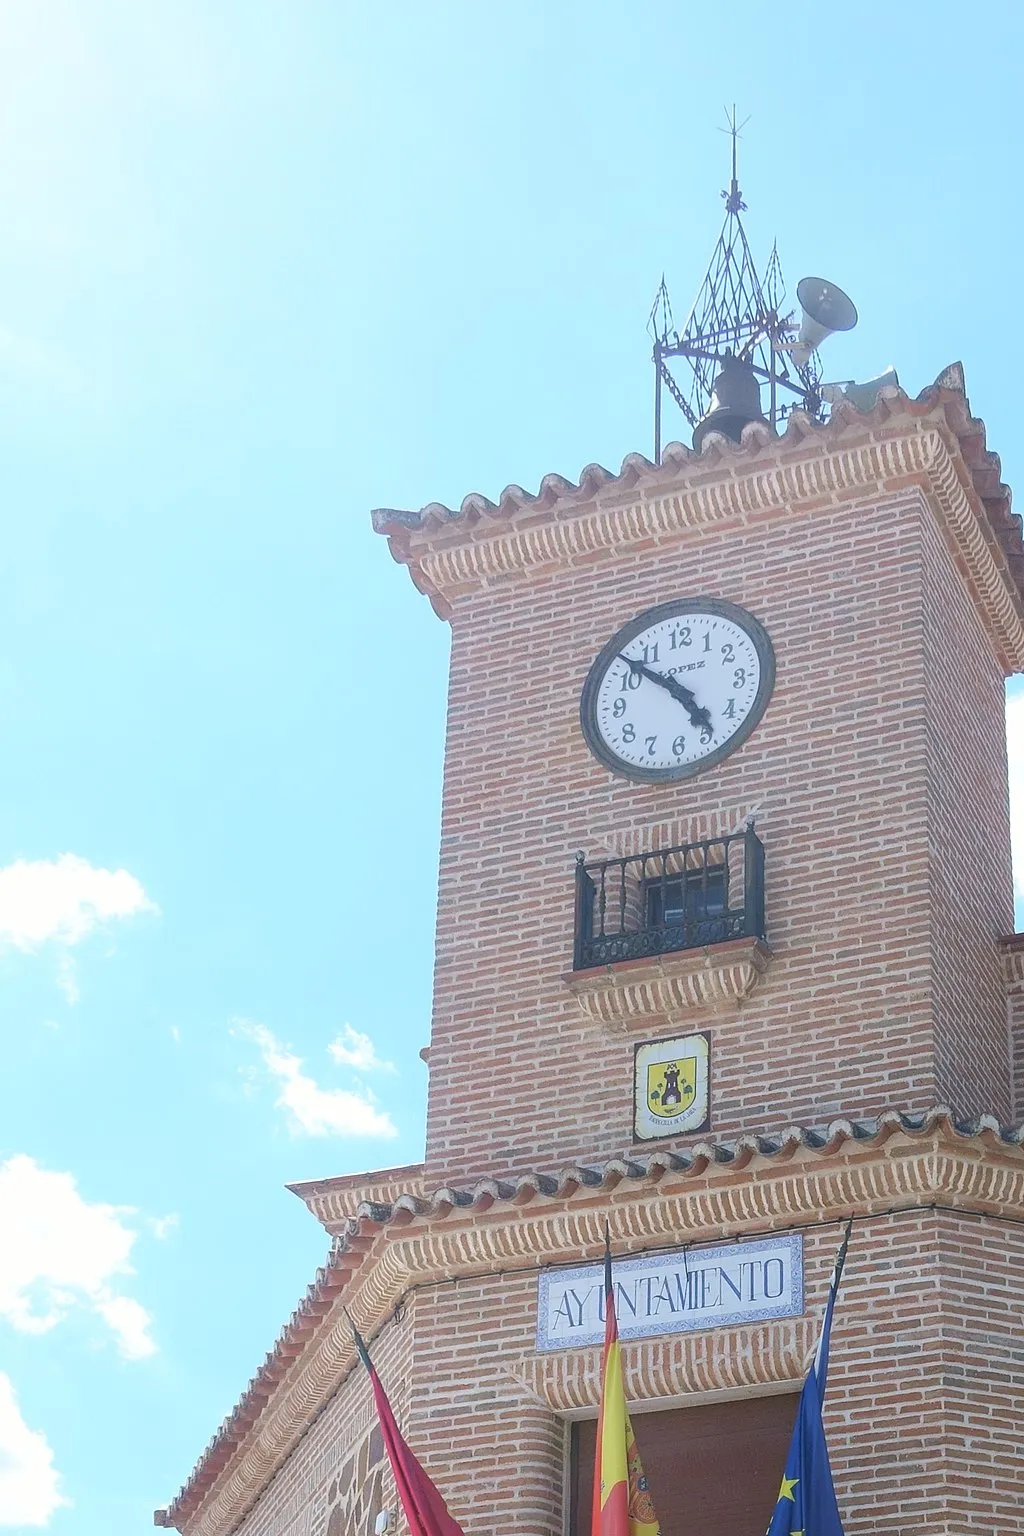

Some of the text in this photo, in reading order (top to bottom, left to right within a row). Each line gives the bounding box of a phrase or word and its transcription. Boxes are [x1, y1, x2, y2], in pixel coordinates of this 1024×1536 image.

[668, 627, 693, 651] 12
[702, 631, 713, 653] 1
[642, 642, 661, 664] 11
[721, 643, 736, 666] 2
[658, 660, 706, 677] LOPEZ
[732, 668, 746, 689] 3
[619, 670, 643, 692] 10
[612, 697, 627, 718] 9
[721, 698, 737, 719] 4
[621, 723, 636, 743] 8
[699, 724, 713, 745] 5
[644, 735, 658, 756] 7
[671, 735, 686, 757] 6
[551, 1257, 785, 1331] AYUNTAMIENTO
